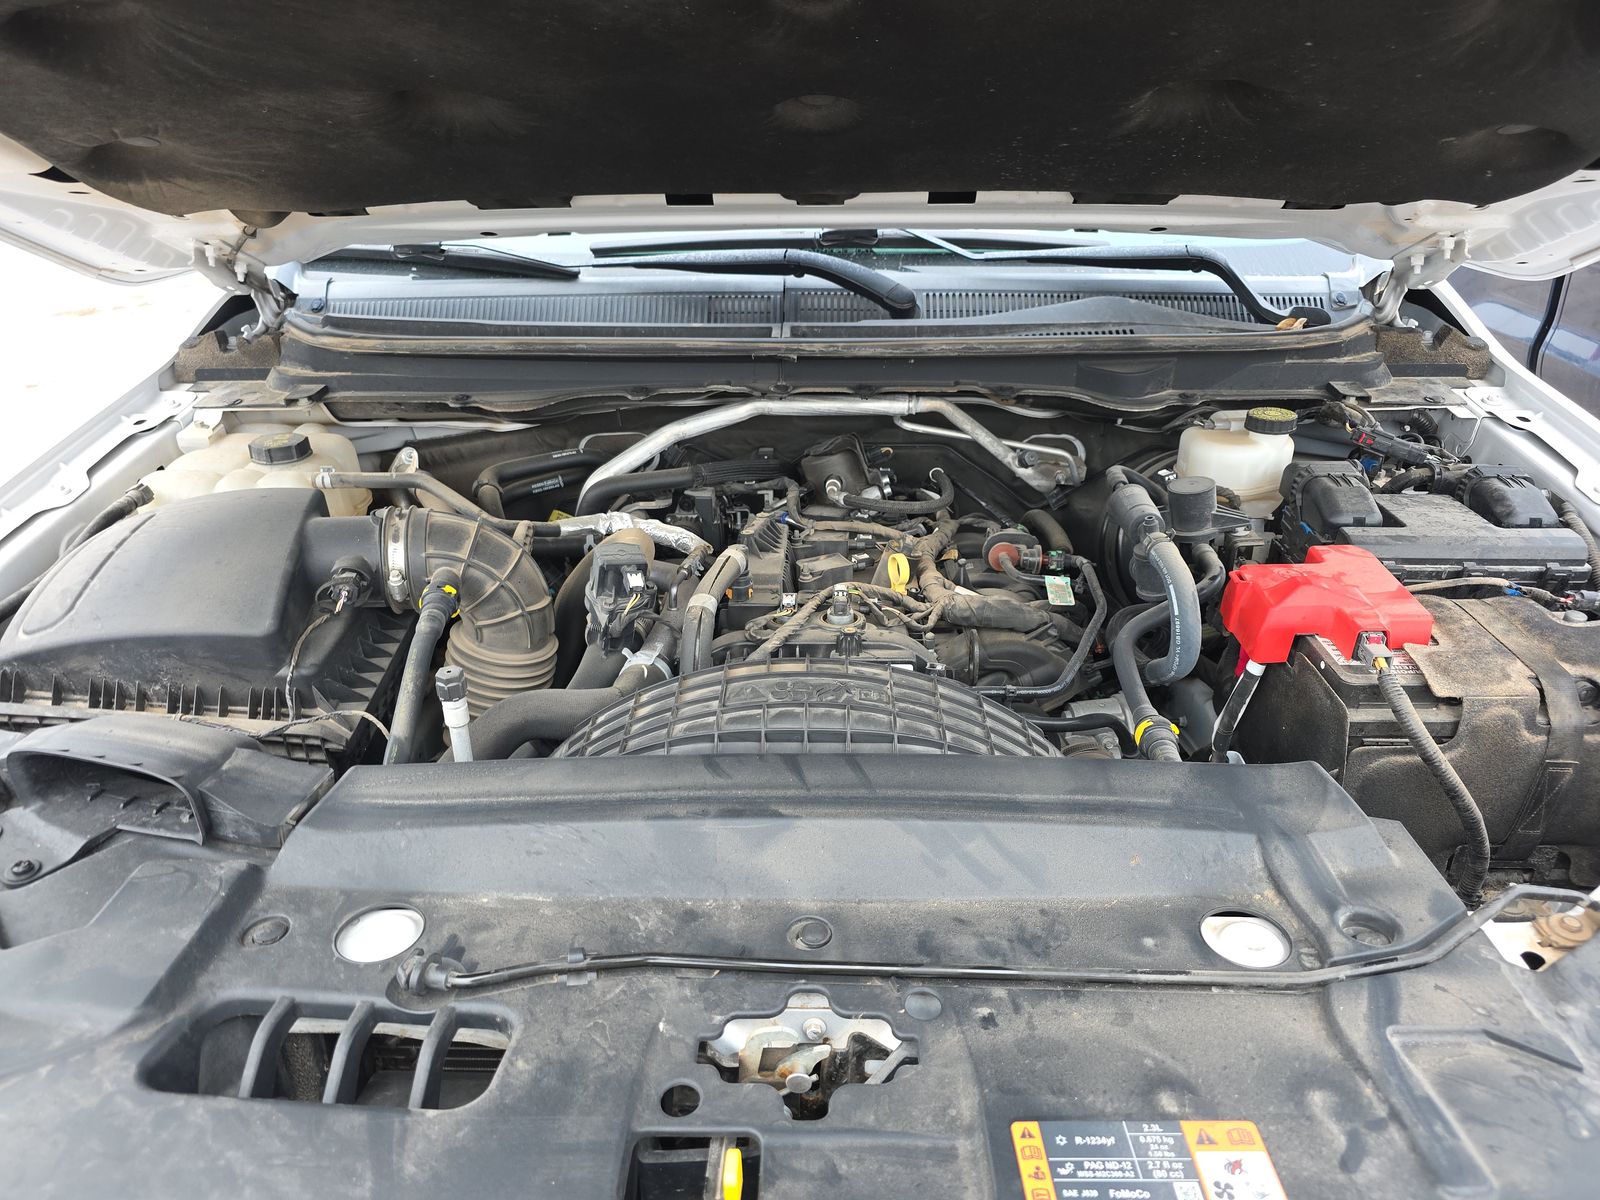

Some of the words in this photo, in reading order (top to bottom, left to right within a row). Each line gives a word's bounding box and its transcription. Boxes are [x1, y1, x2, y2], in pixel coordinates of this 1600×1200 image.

[1074, 1135, 1116, 1148] R-1234yf
[1162, 1135, 1175, 1145] kg
[1083, 1161, 1105, 1170] PAG
[1104, 1161, 1133, 1170] ND-12
[1147, 1160, 1161, 1170] 2.7
[1172, 1162, 1185, 1170] oz
[1169, 1169, 1185, 1179] cc)
[1108, 1188, 1151, 1199] FoMoCo
